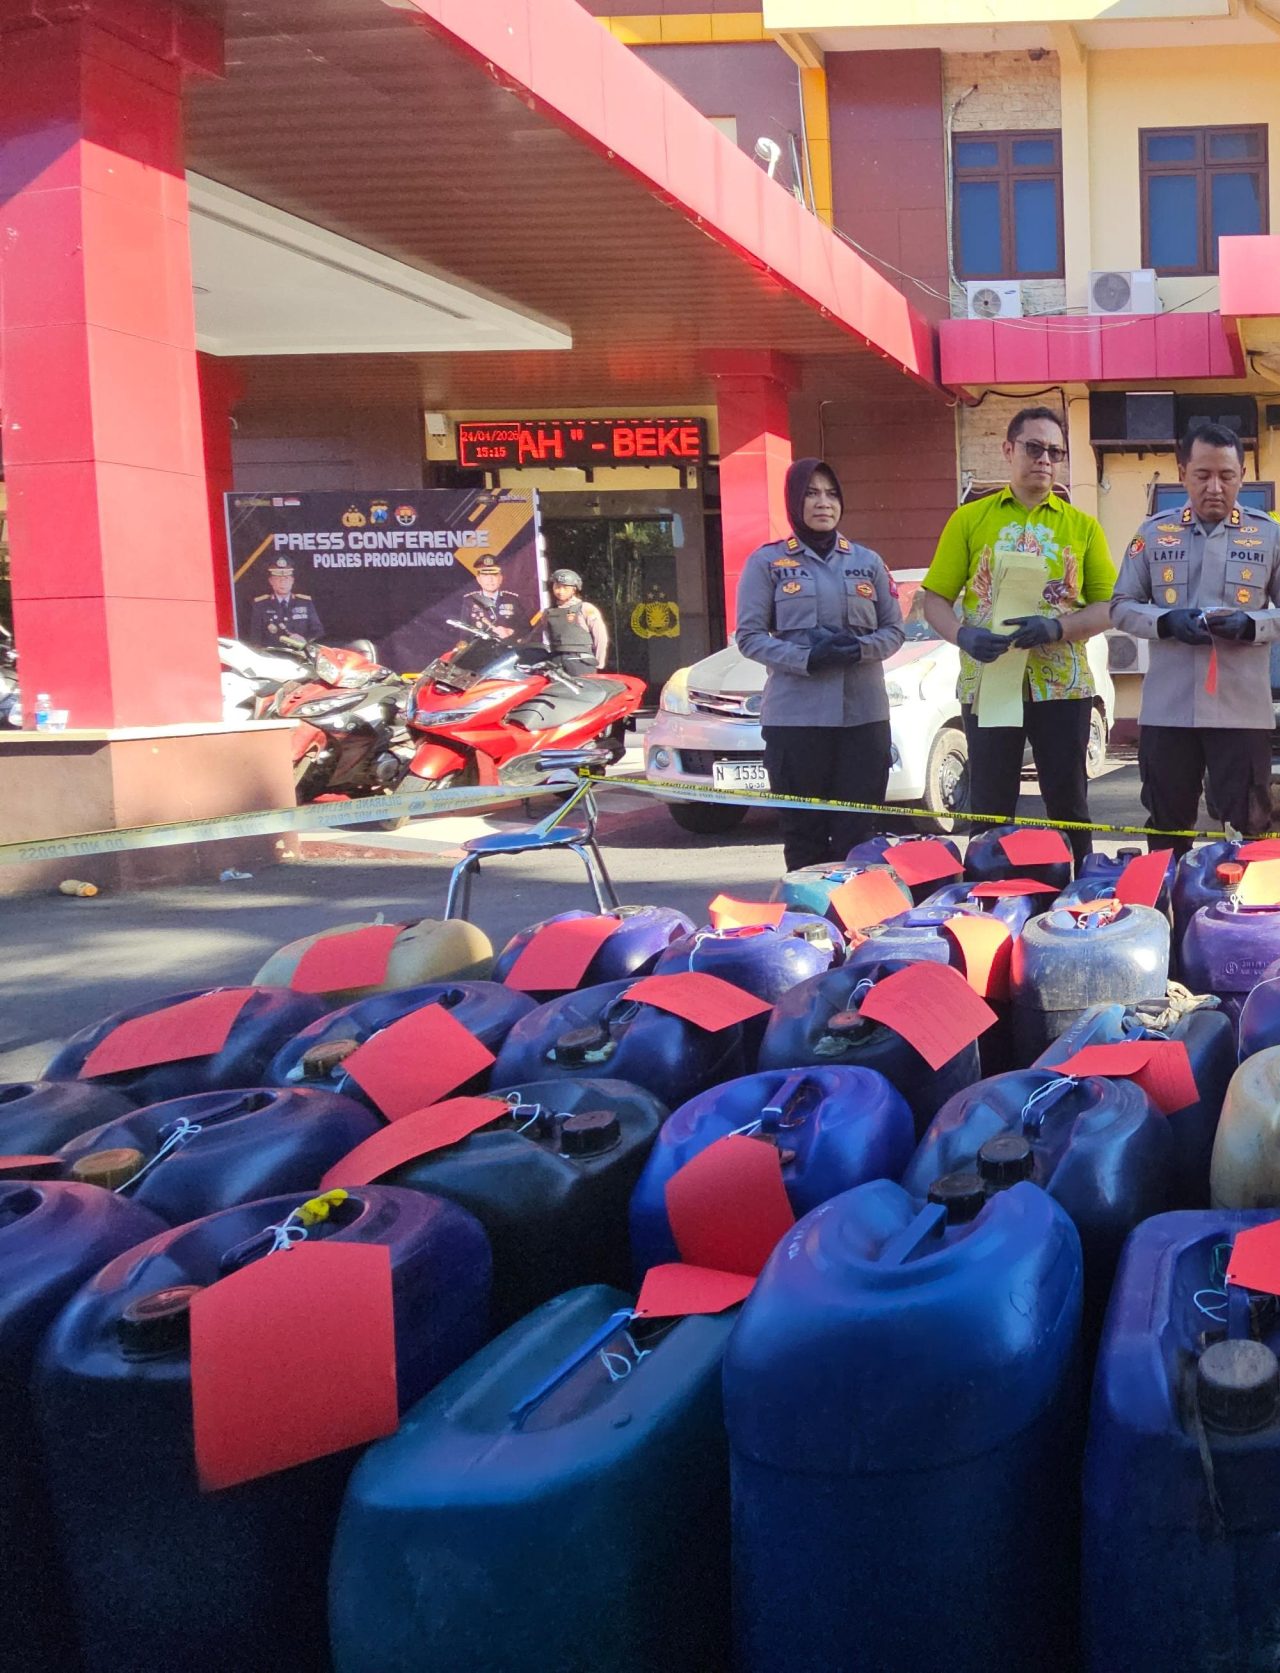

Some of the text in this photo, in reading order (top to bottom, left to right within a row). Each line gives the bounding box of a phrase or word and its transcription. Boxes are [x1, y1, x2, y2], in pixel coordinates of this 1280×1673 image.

[520, 429, 564, 458] AH
[613, 427, 699, 457] BEKE
[476, 446, 506, 458] 15:15
[274, 530, 490, 550] PRESS CONFERENCE
[313, 551, 454, 568] POLRES PROBOLINGGO
[1154, 551, 1186, 561] LATIF
[1230, 551, 1265, 563] POLRI
[774, 568, 809, 578] VITA
[716, 765, 766, 781] N 1535
